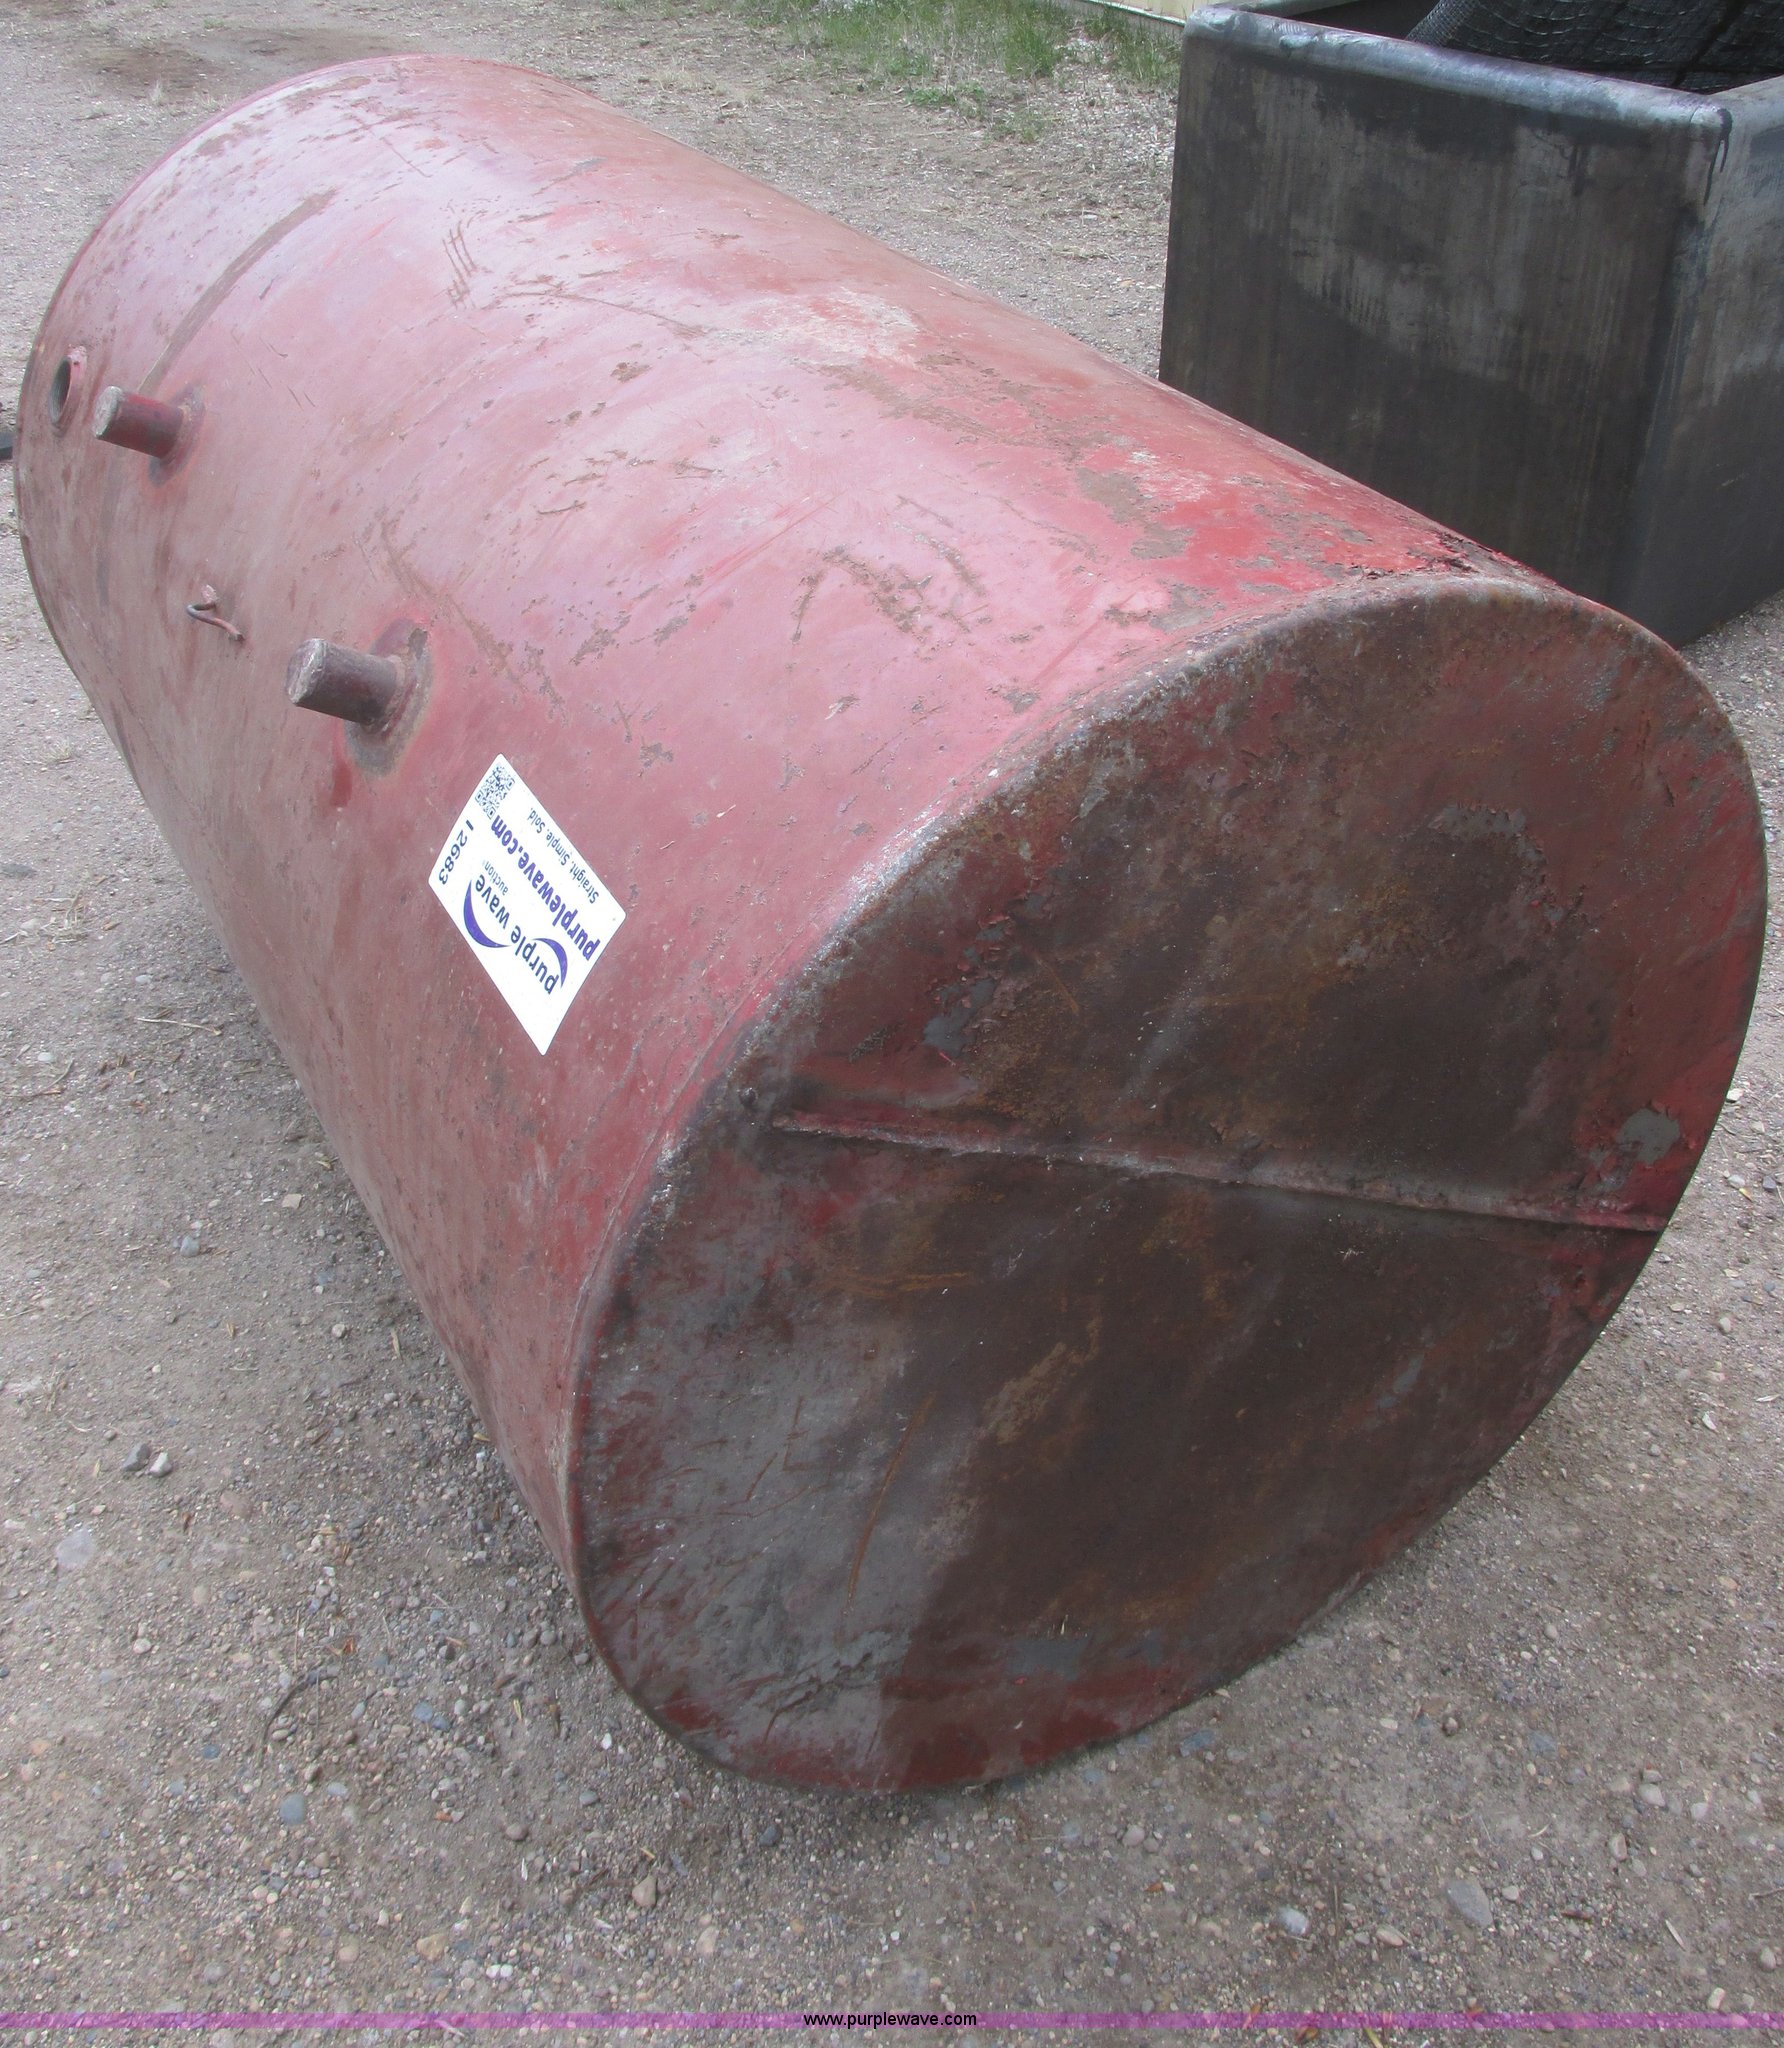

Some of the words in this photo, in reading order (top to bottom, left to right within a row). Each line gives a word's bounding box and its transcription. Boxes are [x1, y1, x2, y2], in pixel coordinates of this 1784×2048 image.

[527, 807, 546, 834] Sold.
[546, 826, 570, 866] Simple.
[484, 861, 509, 896] auction
[490, 814, 601, 962] purplewave.com
[571, 860, 600, 904] Straight.
[475, 873, 510, 929] wave
[510, 925, 560, 995] purple
